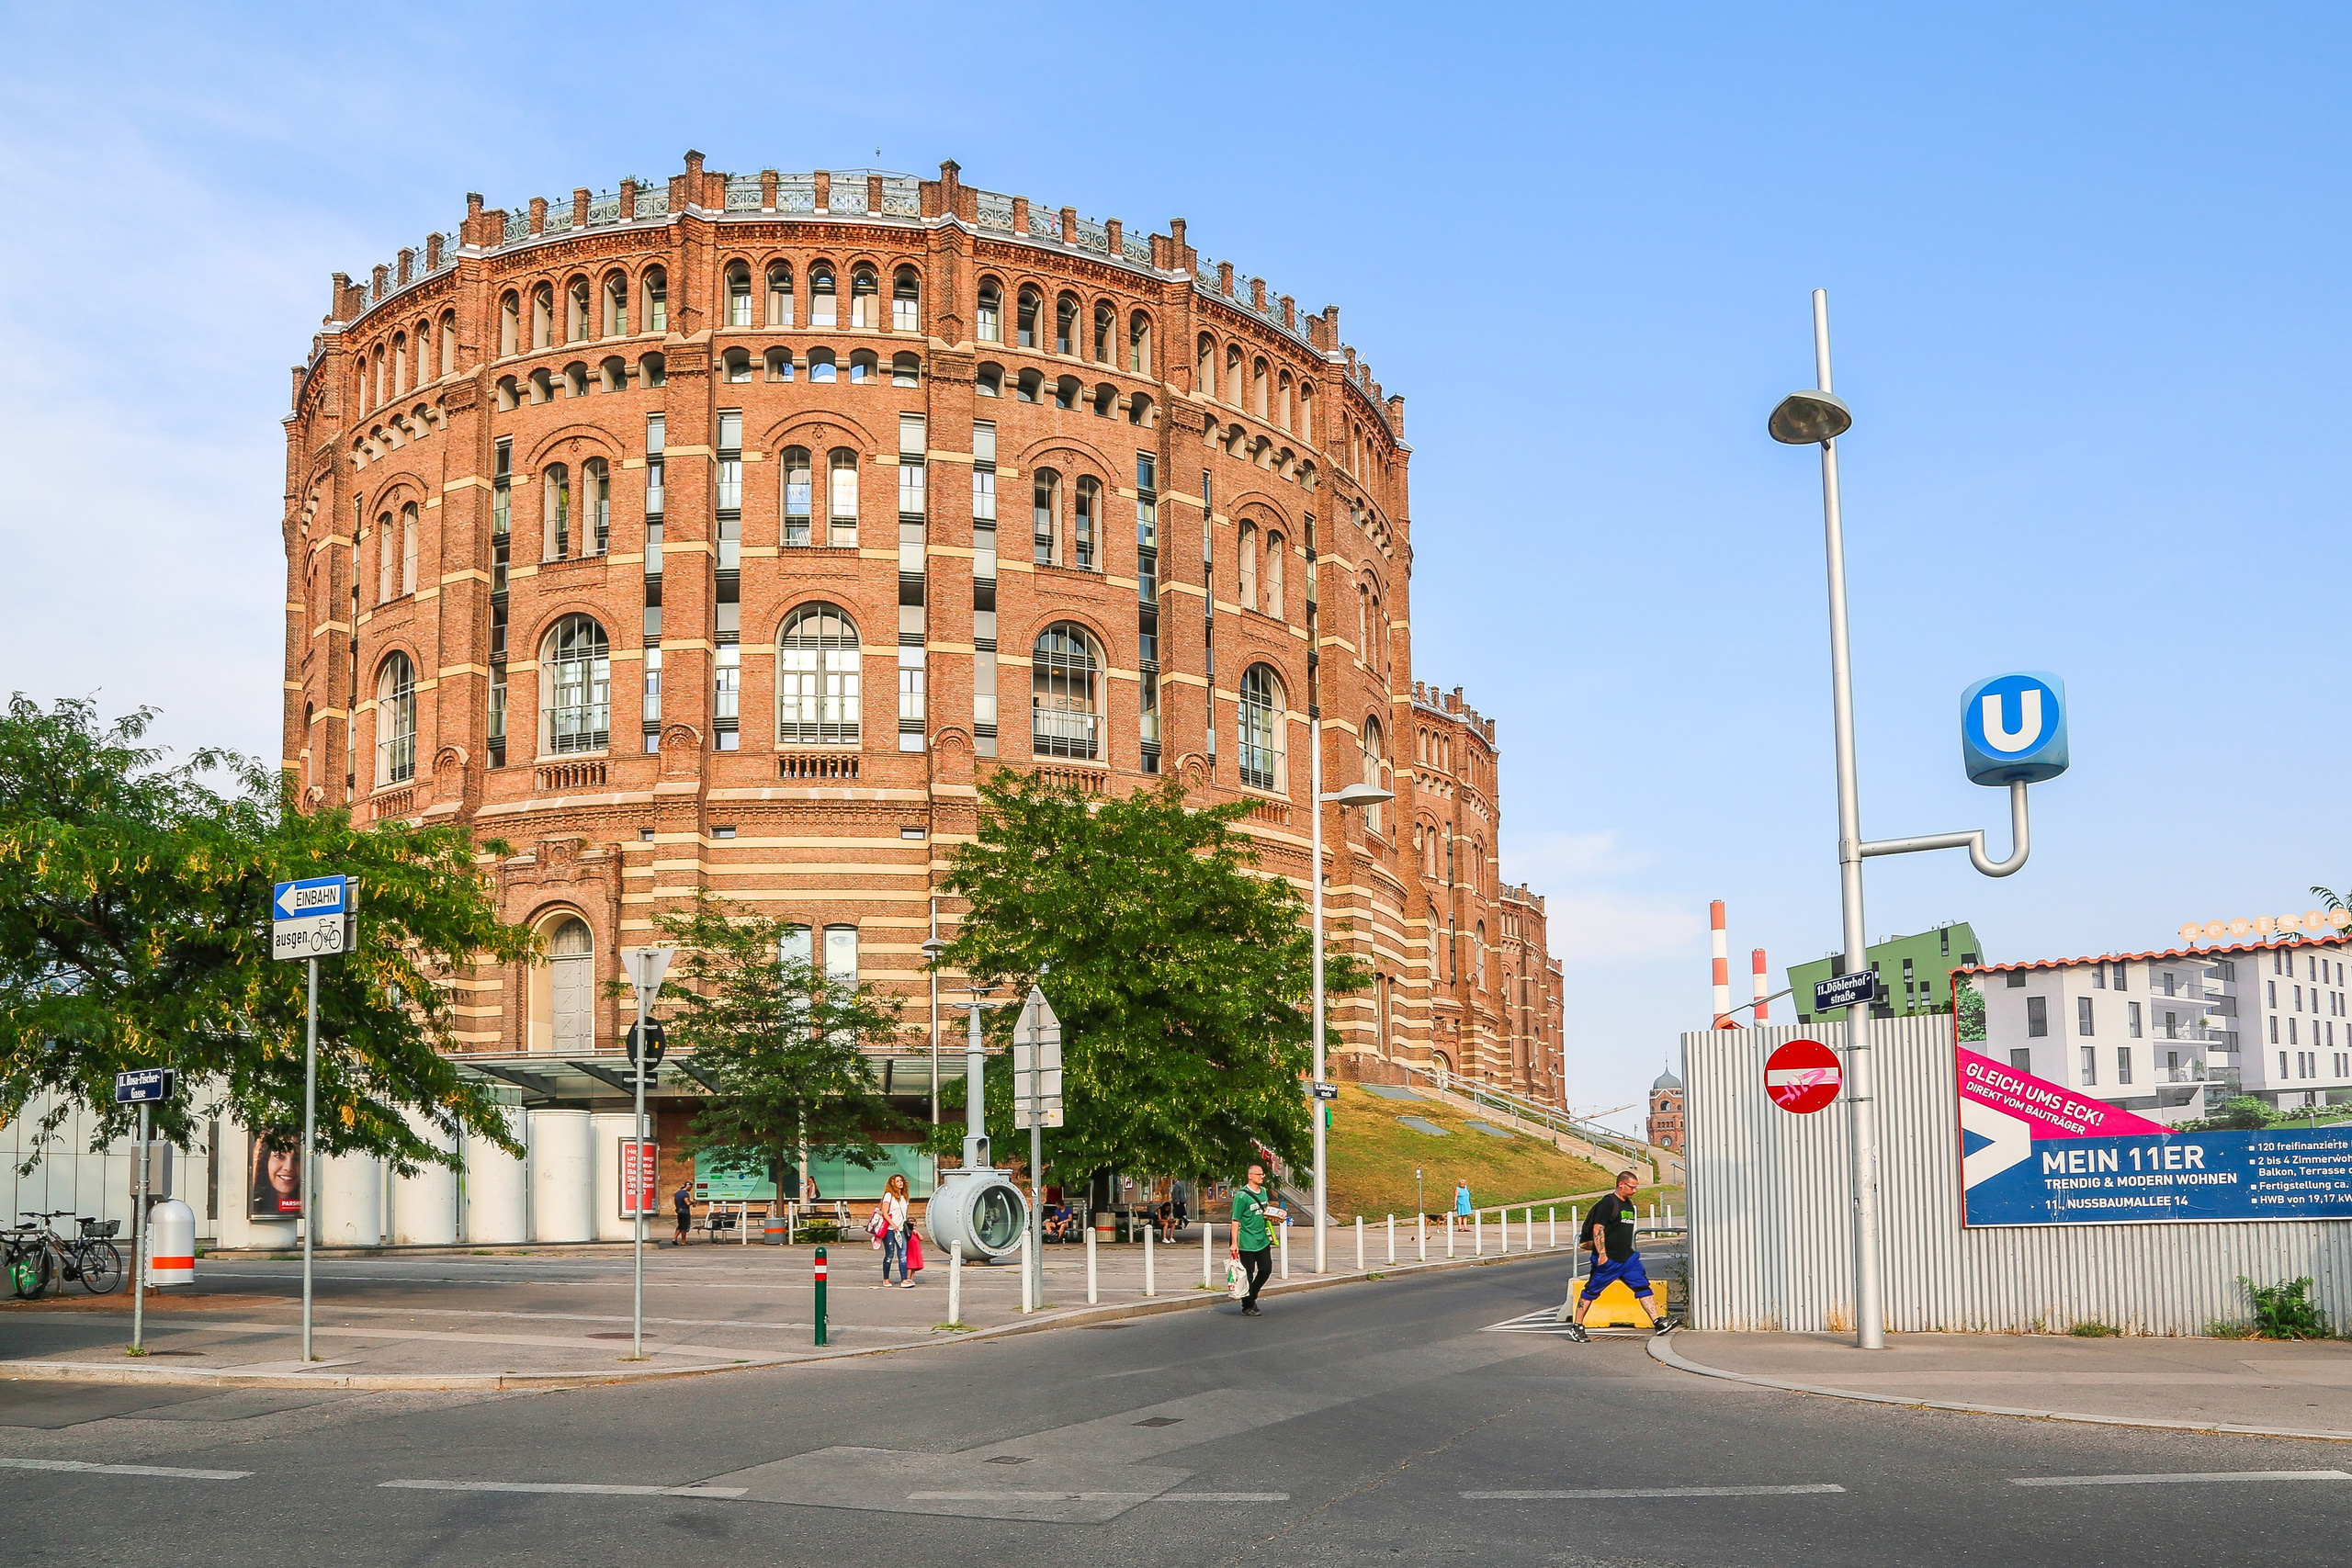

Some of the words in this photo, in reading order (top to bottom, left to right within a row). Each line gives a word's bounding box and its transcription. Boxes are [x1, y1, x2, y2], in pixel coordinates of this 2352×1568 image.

[1982, 689, 2042, 753] U
[296, 887, 336, 907] EINBAHN
[2184, 912, 2347, 939] gewista
[276, 931, 311, 949] ausgen.
[1830, 990, 1856, 1004] straße
[130, 1088, 146, 1099] Gasse
[1965, 1063, 2025, 1096] GLEICH
[2025, 1087, 2063, 1110] UMS
[2063, 1100, 2105, 1127] ECK!
[1965, 1081, 2003, 1101] DIREKT
[2003, 1095, 2025, 1111] VOM
[2024, 1105, 2086, 1135] BAUTRÄGER
[2257, 1143, 2275, 1151] 120
[2277, 1141, 2348, 1151] freifinanzierte
[2041, 1148, 2119, 1175] MEIN
[2129, 1145, 2205, 1171] 11ER
[2257, 1156, 2265, 1166] 2
[2267, 1156, 2281, 1165] bis
[2283, 1156, 2290, 1165] 4
[2258, 1167, 2297, 1177] Balkon,
[2299, 1167, 2346, 1176] Terrasse
[2044, 1177, 2101, 1190] TRENDIG
[2104, 1177, 2114, 1188] &
[2117, 1174, 2173, 1188] MODERN
[2176, 1172, 2237, 1185] WOHNEN
[2259, 1180, 2332, 1191] Fertigstellung
[2066, 1196, 2171, 1209] NUSSBAUMALLEE
[2174, 1195, 2188, 1206] 14
[2260, 1195, 2285, 1204] HWB
